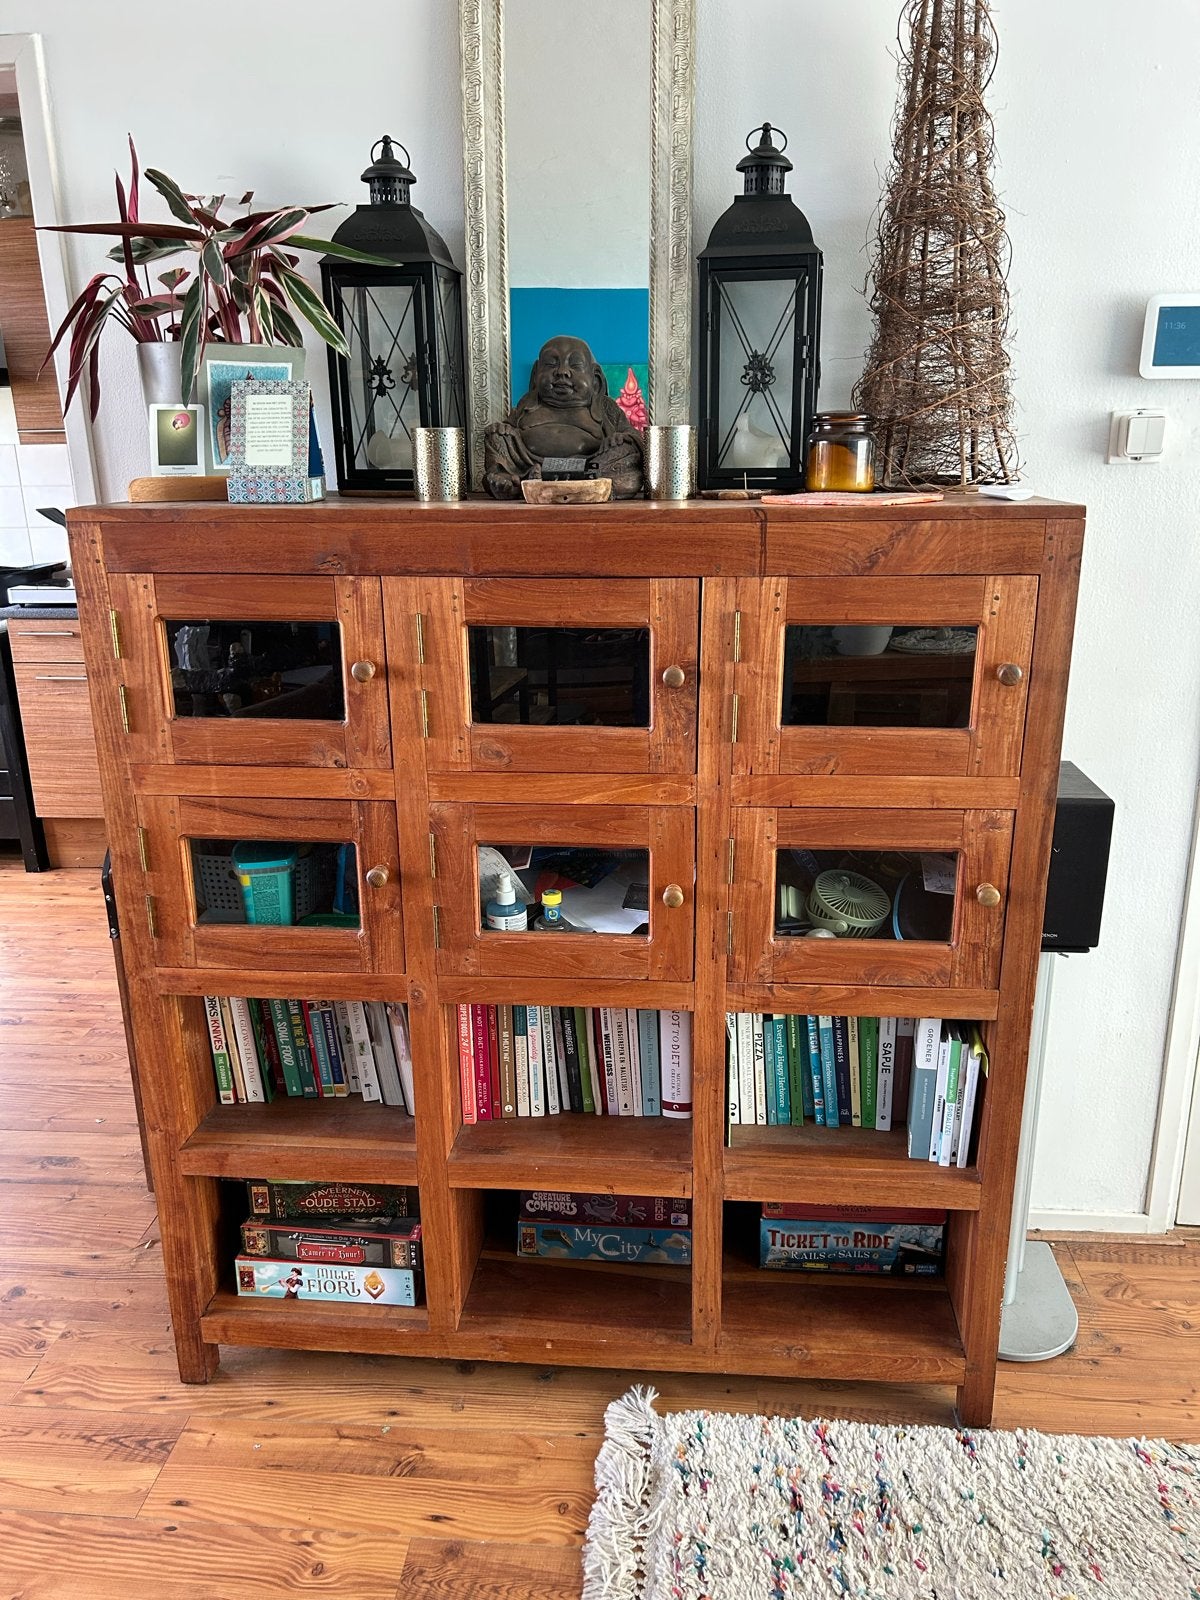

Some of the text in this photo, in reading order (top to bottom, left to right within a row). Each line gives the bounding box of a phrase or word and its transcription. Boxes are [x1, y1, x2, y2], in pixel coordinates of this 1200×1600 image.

[1164, 321, 1186, 330] 11:36
[291, 1015, 300, 1024] ON
[210, 1020, 224, 1051] KNIVES
[277, 1022, 290, 1044] SOUL
[292, 1025, 303, 1036] THE
[564, 1020, 574, 1054] HAMBURGERS
[672, 1030, 680, 1042] TO
[240, 1020, 250, 1047] GLOWS
[248, 1068, 256, 1083] DAG
[296, 1038, 306, 1047] GO
[755, 1033, 763, 1061] PIZZA
[809, 1032, 818, 1054] VEGAN
[926, 1028, 934, 1063] GROENER
[281, 1045, 294, 1066] FOOD
[672, 1044, 680, 1068] DIET
[882, 1042, 892, 1074] SAPJE
[532, 1192, 571, 1202] CREATURE
[526, 1200, 578, 1216] COMFORTS
[574, 1228, 642, 1260] My City
[768, 1230, 894, 1249] TICKET TO RIDE
[302, 1248, 325, 1256] Kamer
[338, 1250, 360, 1260] Huur!
[791, 1251, 826, 1260] RAILS
[838, 1250, 870, 1259] SAILS
[316, 1268, 356, 1281] MILLE
[307, 1278, 361, 1298] FIORI
